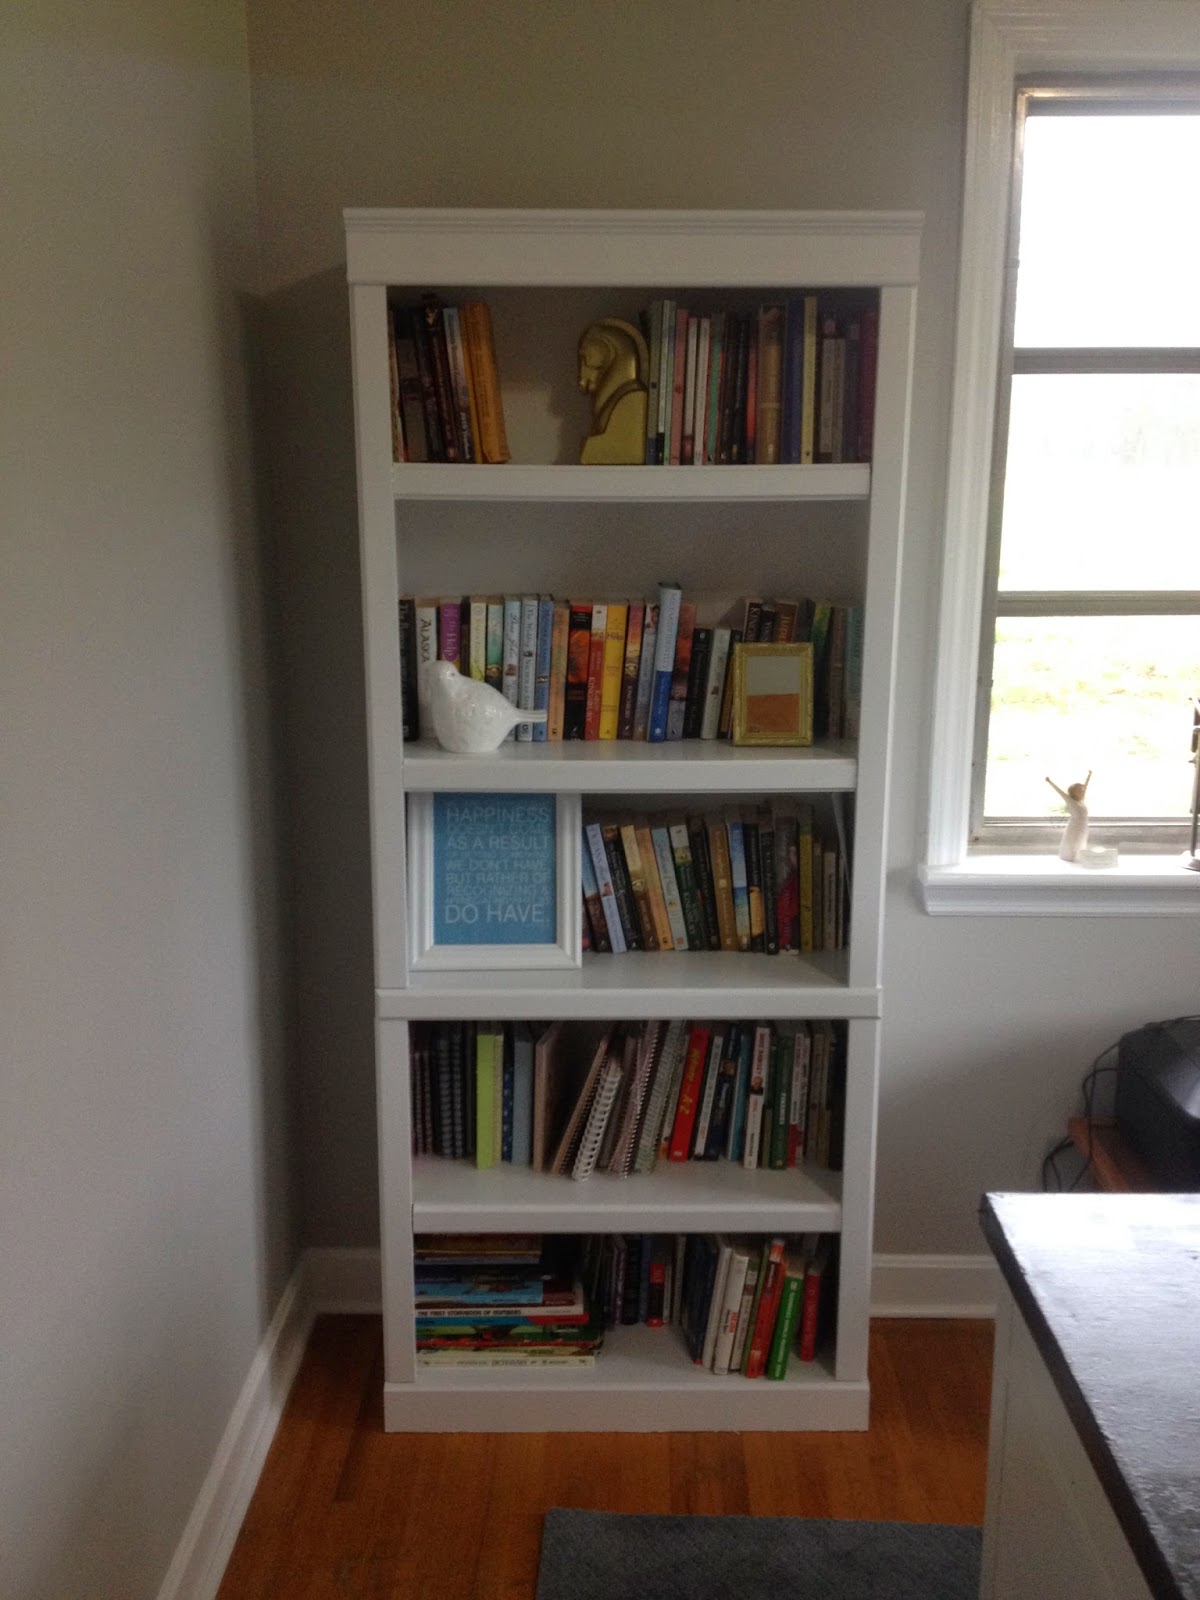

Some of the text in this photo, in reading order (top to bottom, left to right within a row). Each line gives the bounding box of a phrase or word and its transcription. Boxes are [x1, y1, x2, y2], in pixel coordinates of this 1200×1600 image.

[420, 618, 431, 663] ALASKA
[444, 632, 456, 657] Help
[447, 807, 550, 823] HAPPINESS
[447, 835, 551, 850] AS A RESULT
[445, 904, 479, 924] DO
